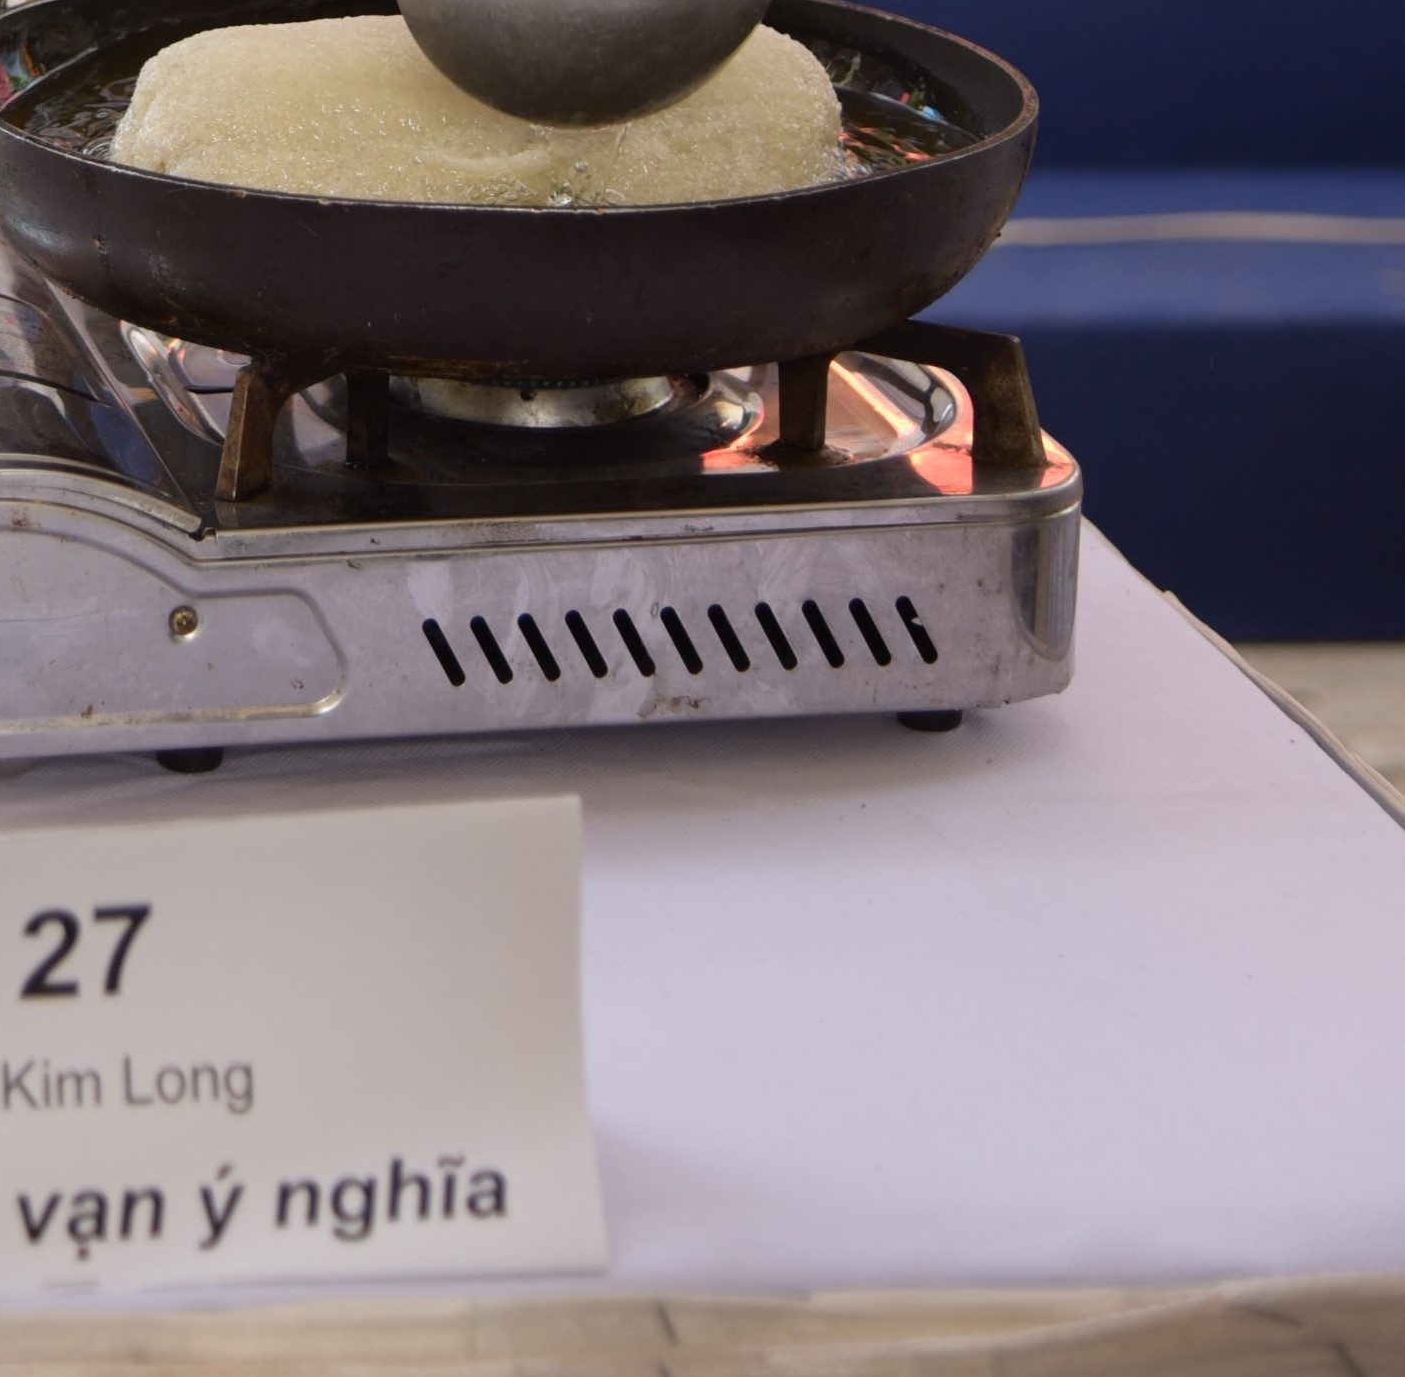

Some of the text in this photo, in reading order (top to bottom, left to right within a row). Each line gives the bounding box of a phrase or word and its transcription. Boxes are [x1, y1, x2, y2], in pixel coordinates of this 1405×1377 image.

[19, 902, 153, 1001] 27
[2, 1057, 102, 1110] Kim
[122, 1053, 255, 1115] Long
[16, 1183, 166, 1261] vạn
[199, 1162, 245, 1250] ý
[275, 1153, 510, 1243] nghĩa
